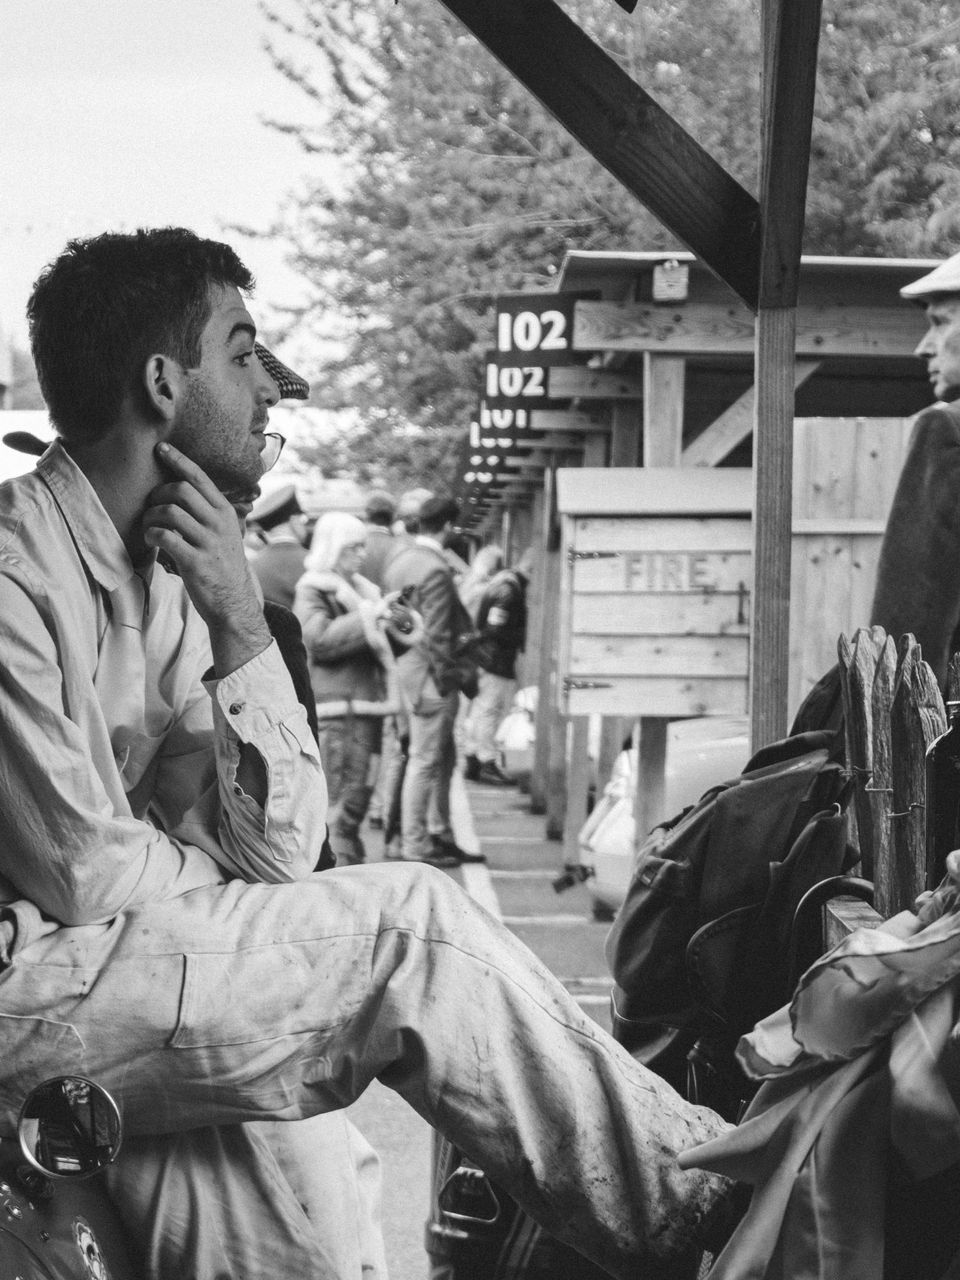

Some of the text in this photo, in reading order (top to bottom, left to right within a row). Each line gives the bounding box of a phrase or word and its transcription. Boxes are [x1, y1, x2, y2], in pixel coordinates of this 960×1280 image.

[498, 310, 568, 352] 102
[486, 363, 545, 397] 102
[625, 553, 715, 589] FIRE
